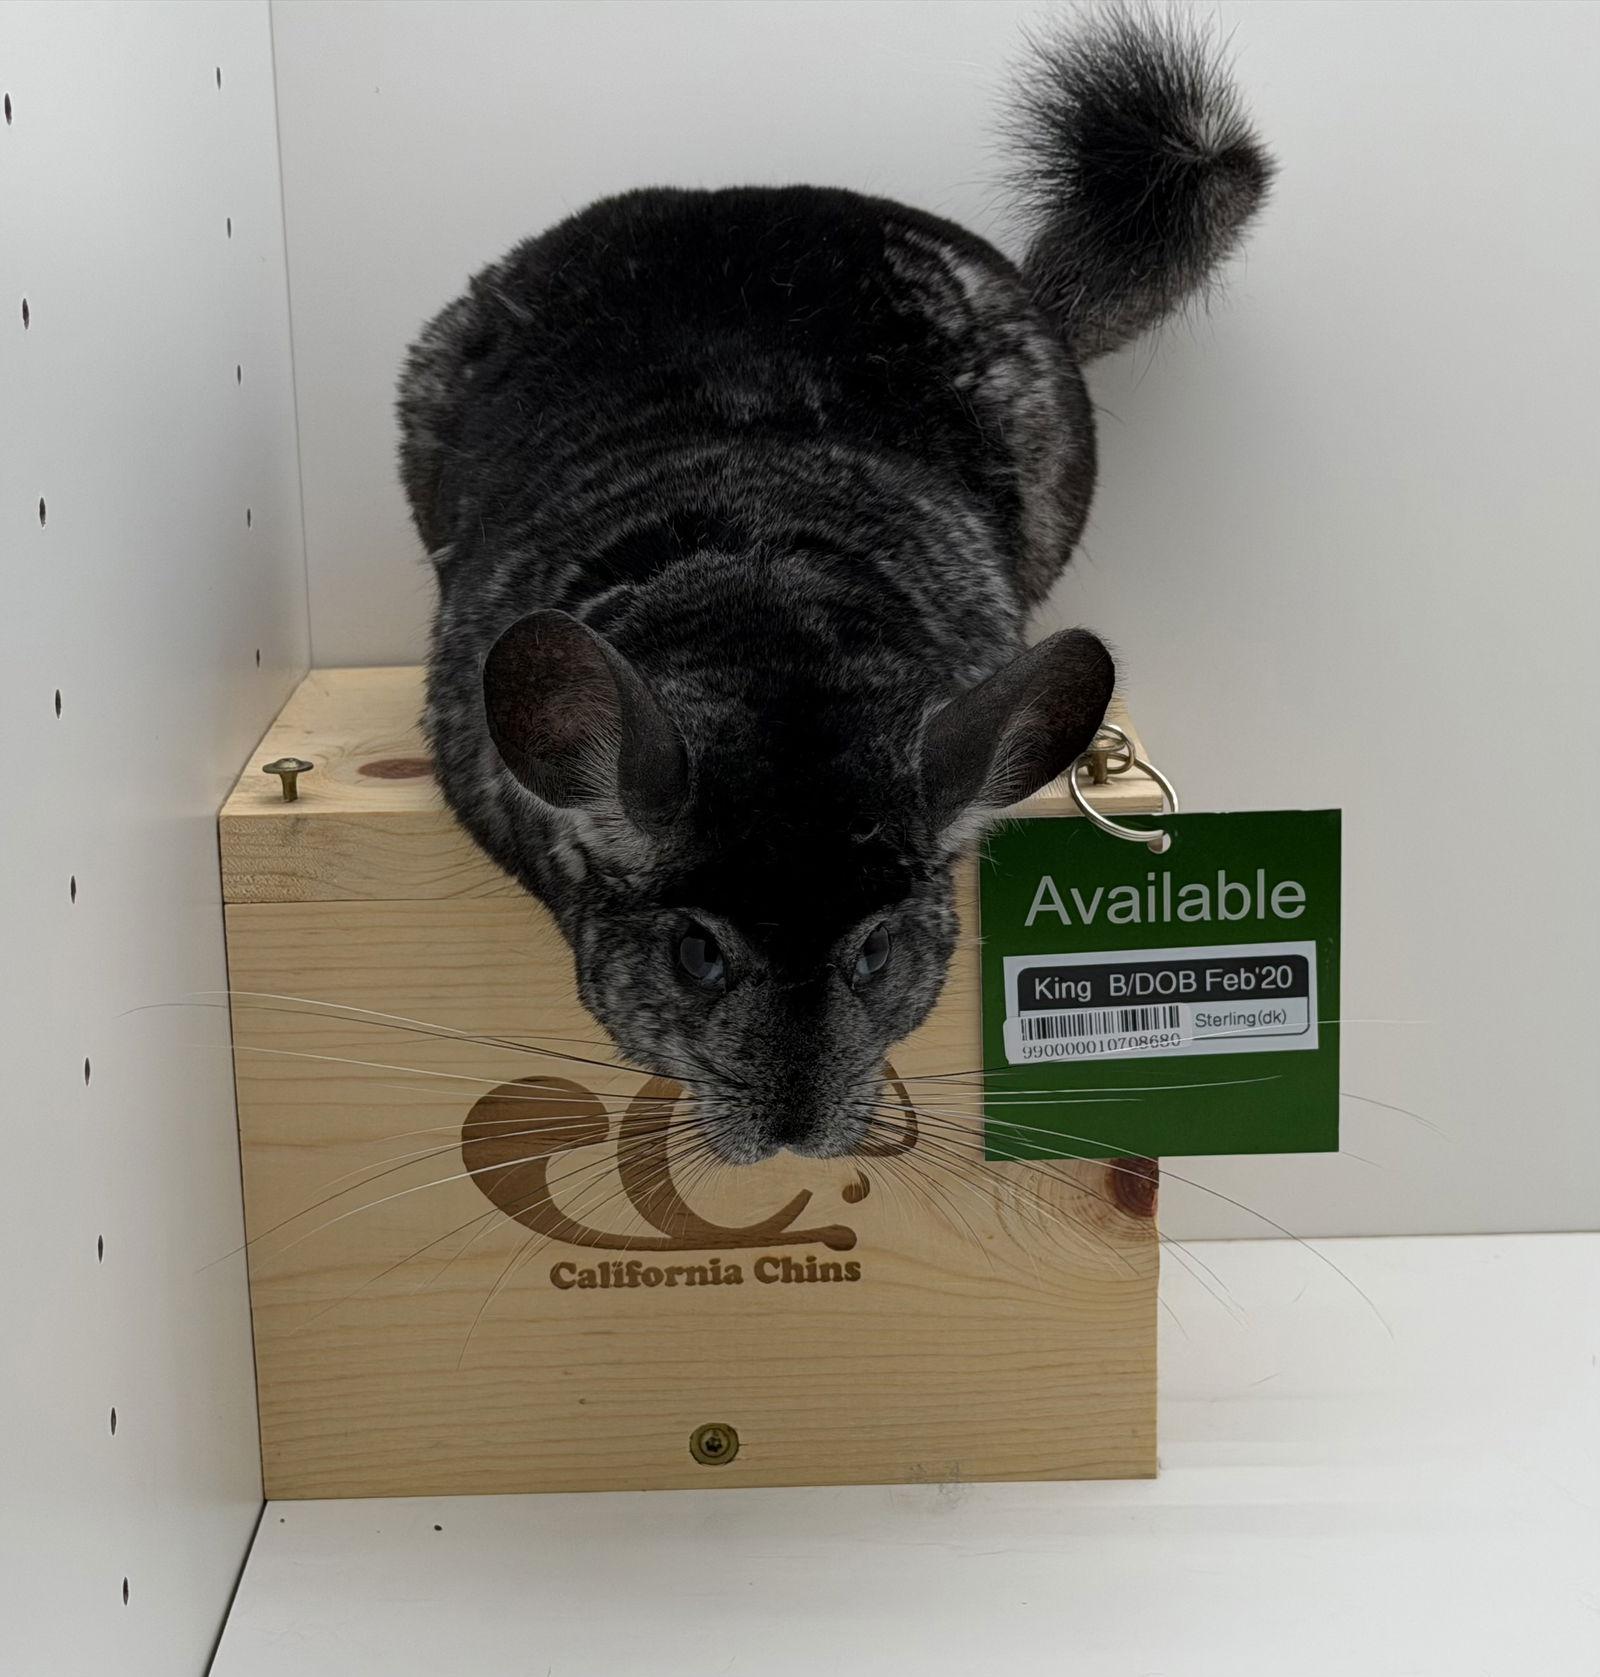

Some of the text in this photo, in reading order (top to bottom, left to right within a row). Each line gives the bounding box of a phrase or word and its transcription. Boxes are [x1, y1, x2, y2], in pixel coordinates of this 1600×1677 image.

[1024, 868, 1307, 927] Available
[1034, 965, 1293, 1002] King B/DOB Feb'20
[1195, 1009, 1287, 1029] Sterling(dk)
[1022, 1032, 1182, 1060] 990000010708680
[549, 1256, 861, 1290] California Chins
